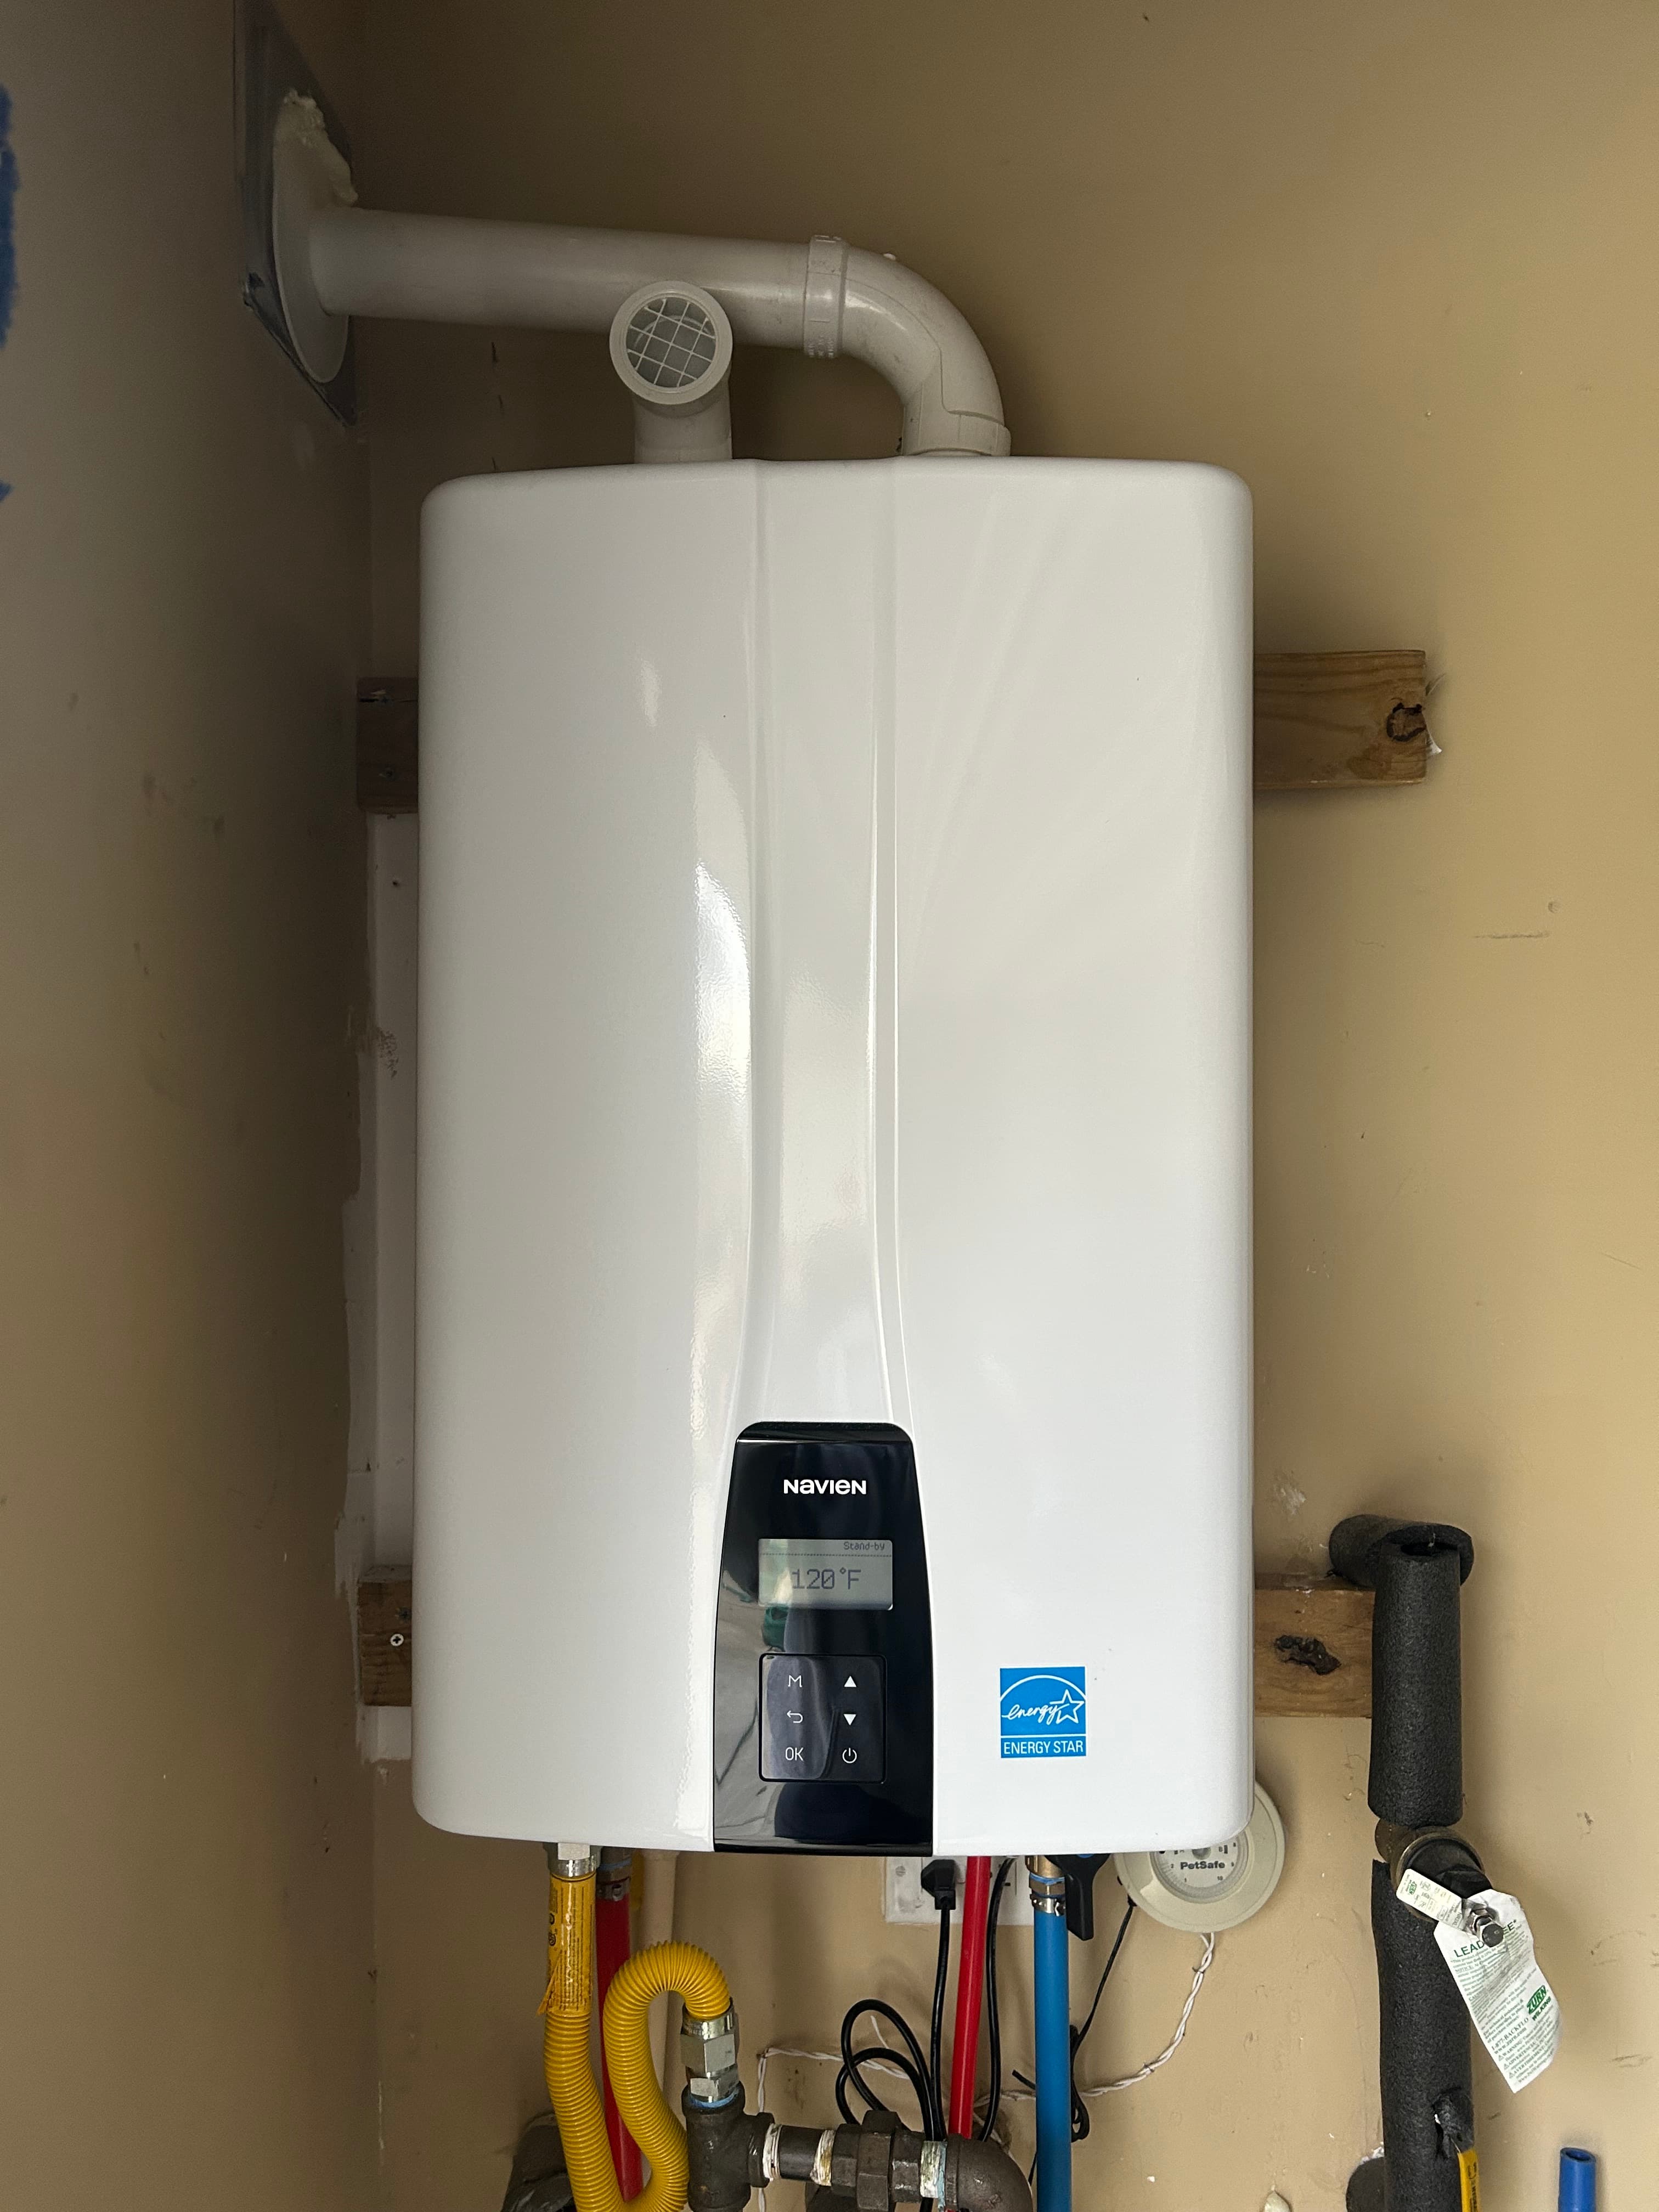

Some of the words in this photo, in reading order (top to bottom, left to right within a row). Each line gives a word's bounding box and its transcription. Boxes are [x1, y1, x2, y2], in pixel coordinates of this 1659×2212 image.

[844, 1542, 884, 1550] Stand-by
[788, 1675, 803, 1688] M
[785, 1747, 803, 1761] OK
[1004, 1741, 1050, 1754] ENERGY
[1053, 1740, 1084, 1753] STAR
[1181, 1861, 1224, 1870] PetSafe
[1454, 1940, 1485, 1957] LEAD
[1528, 1988, 1546, 2013] ZURN
